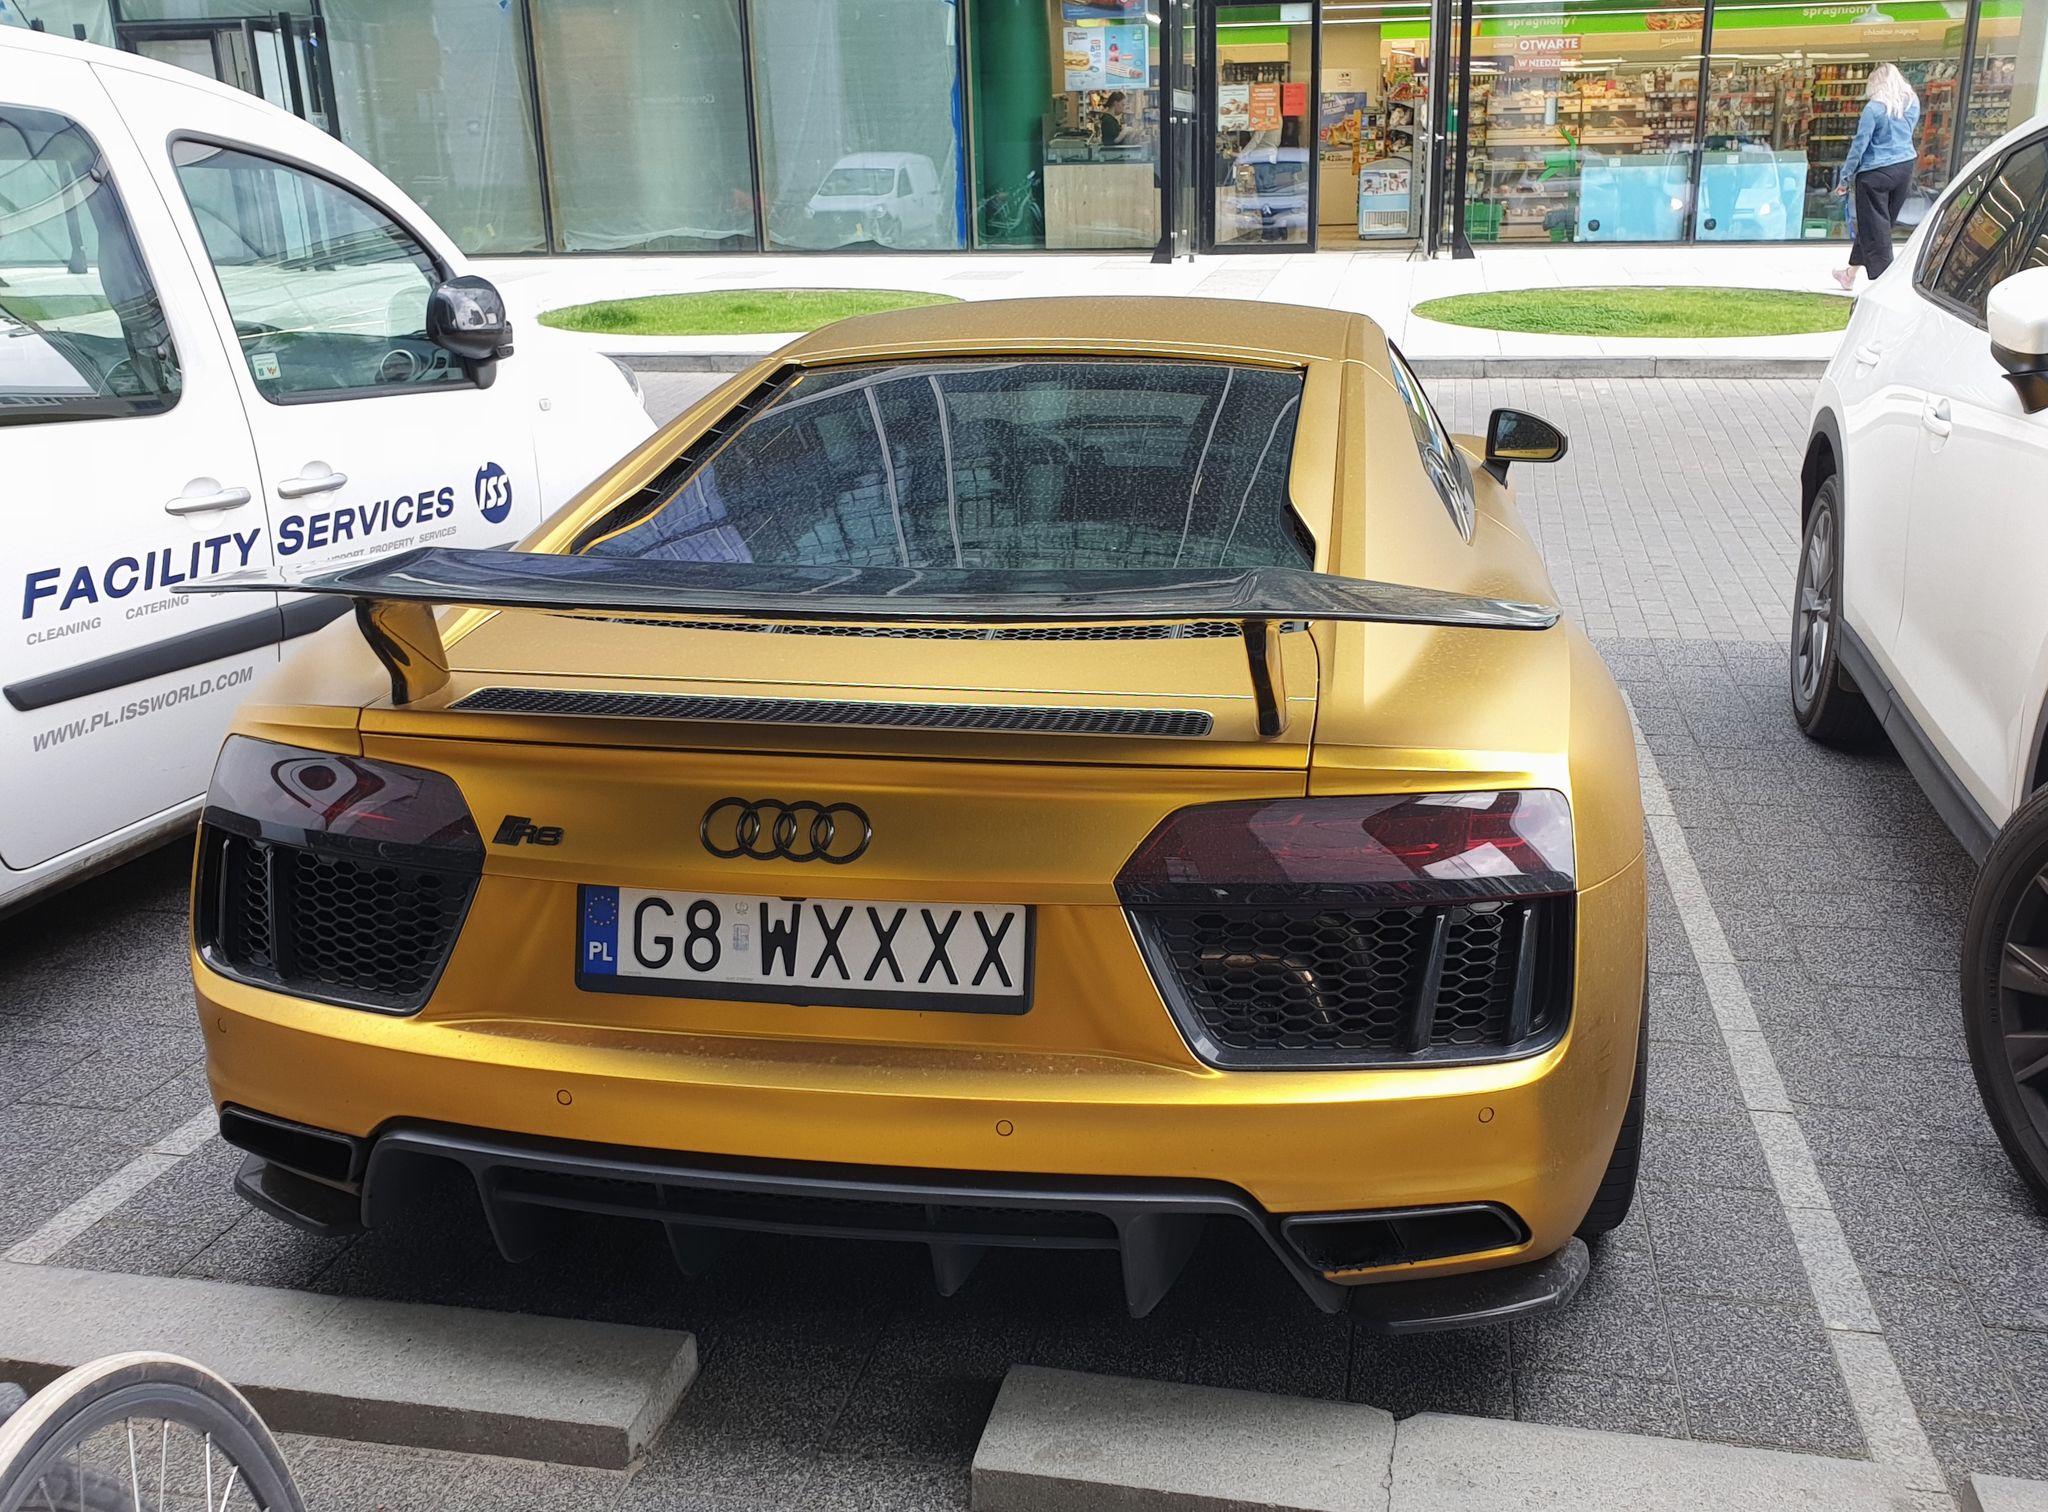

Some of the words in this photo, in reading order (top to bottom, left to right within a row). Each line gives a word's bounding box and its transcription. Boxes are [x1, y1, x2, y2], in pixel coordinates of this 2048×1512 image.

[1518, 59, 1527, 67] W
[1519, 37, 1579, 50] OTWARTE
[22, 528, 261, 619] FACILITY
[277, 487, 455, 555] SERVICES
[26, 617, 102, 645] CLEANING
[125, 595, 190, 620] CATERING
[369, 536, 415, 554] PROPERTY
[419, 526, 457, 543] SERVICES
[33, 666, 254, 752] WWW.PL.ISSWORLD.COM
[588, 941, 613, 961] PL
[633, 897, 721, 972] G8
[759, 902, 1015, 988] WXXXX
